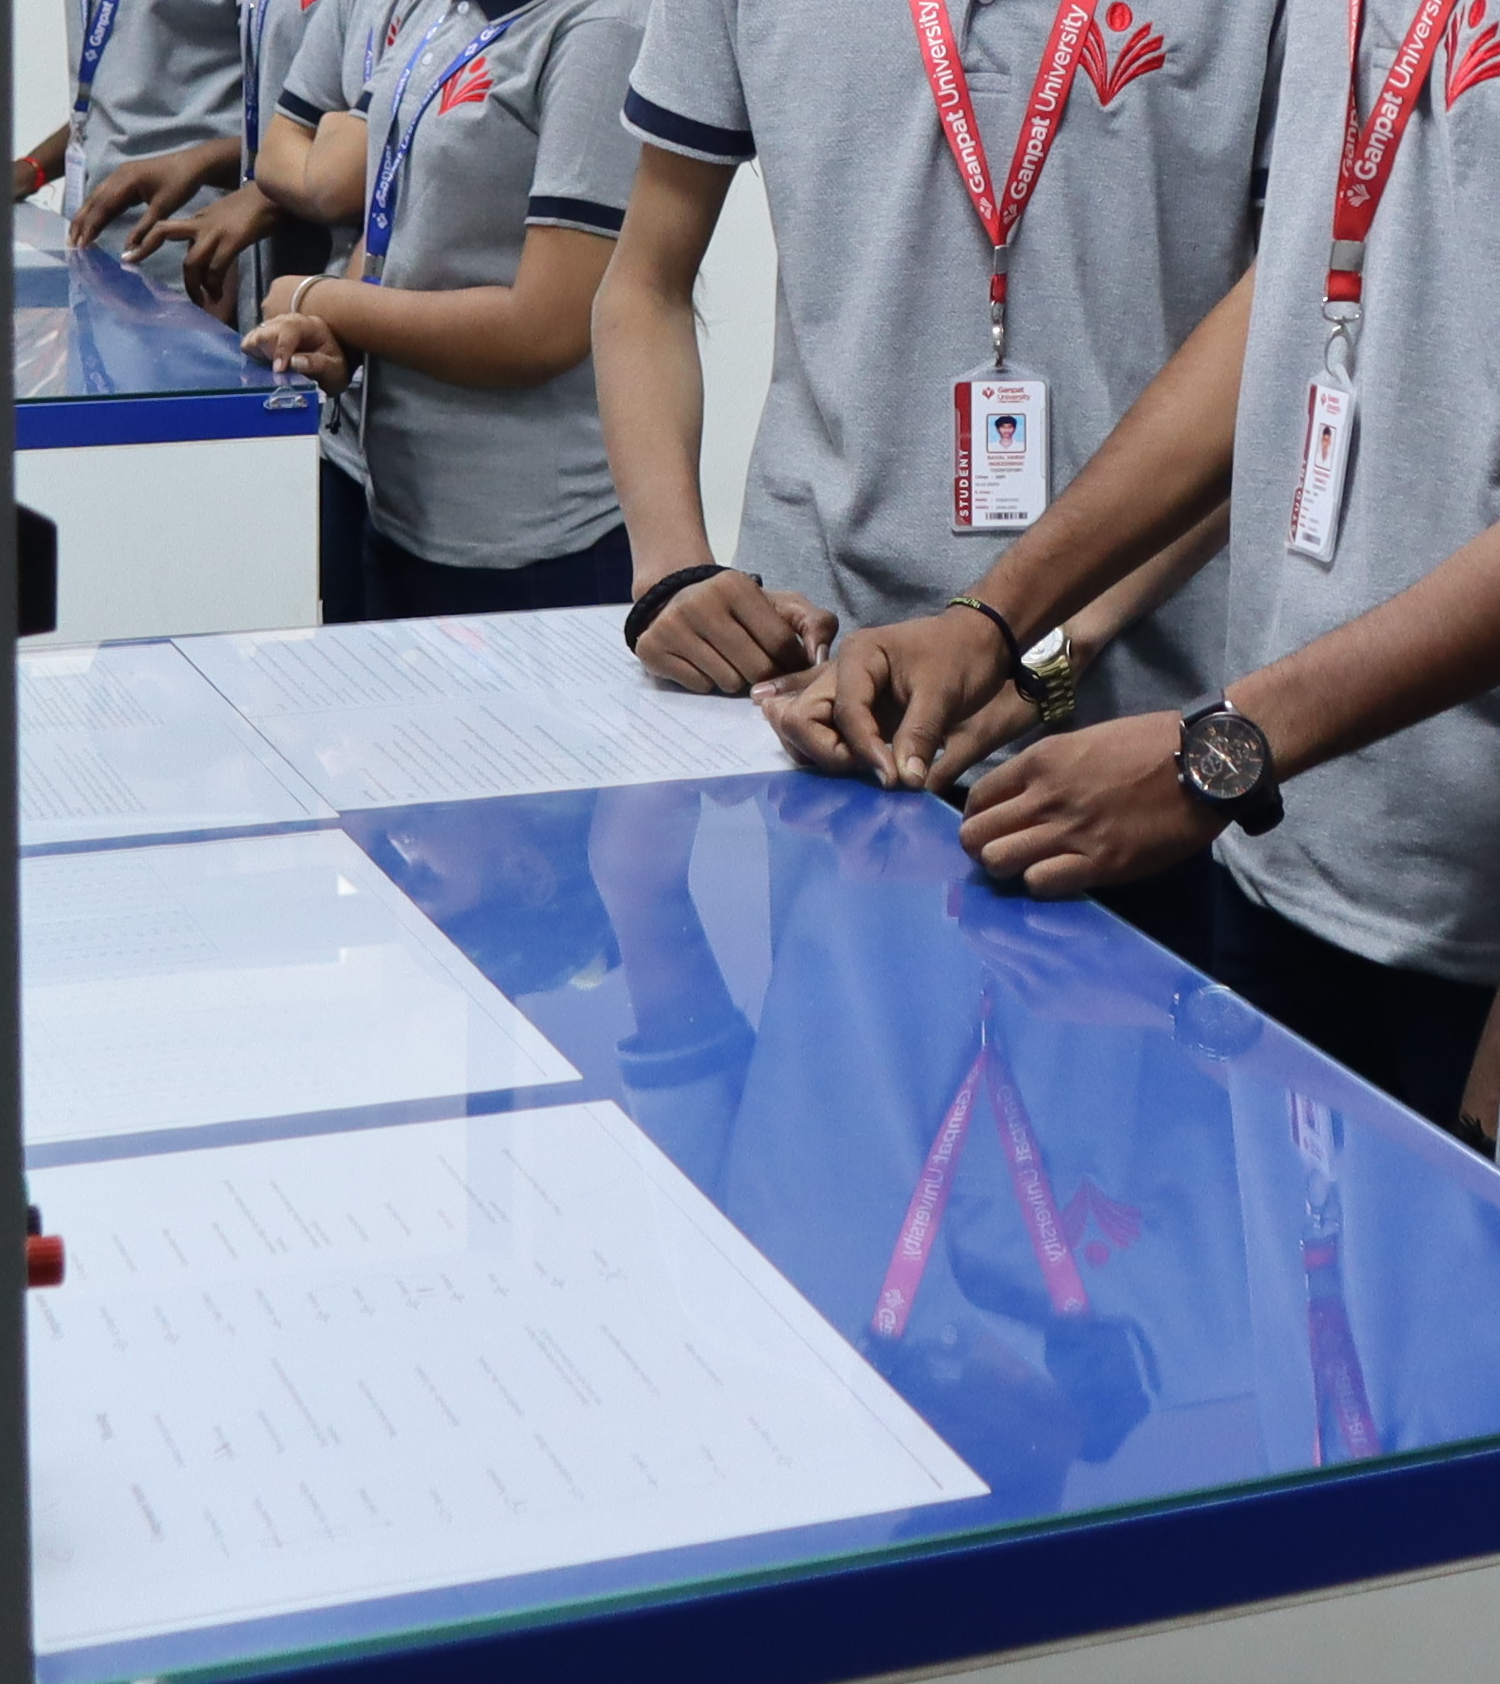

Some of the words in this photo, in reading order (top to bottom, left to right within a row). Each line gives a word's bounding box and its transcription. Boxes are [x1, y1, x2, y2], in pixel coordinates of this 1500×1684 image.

[89, 2, 113, 47] Ganpat
[918, 0, 960, 104] University
[1010, 119, 1051, 200] Ganpat
[1034, 4, 1089, 113] University
[1353, 89, 1402, 181] Ganpat
[946, 108, 986, 194] Ganpat
[959, 449, 970, 517] STUDENT
